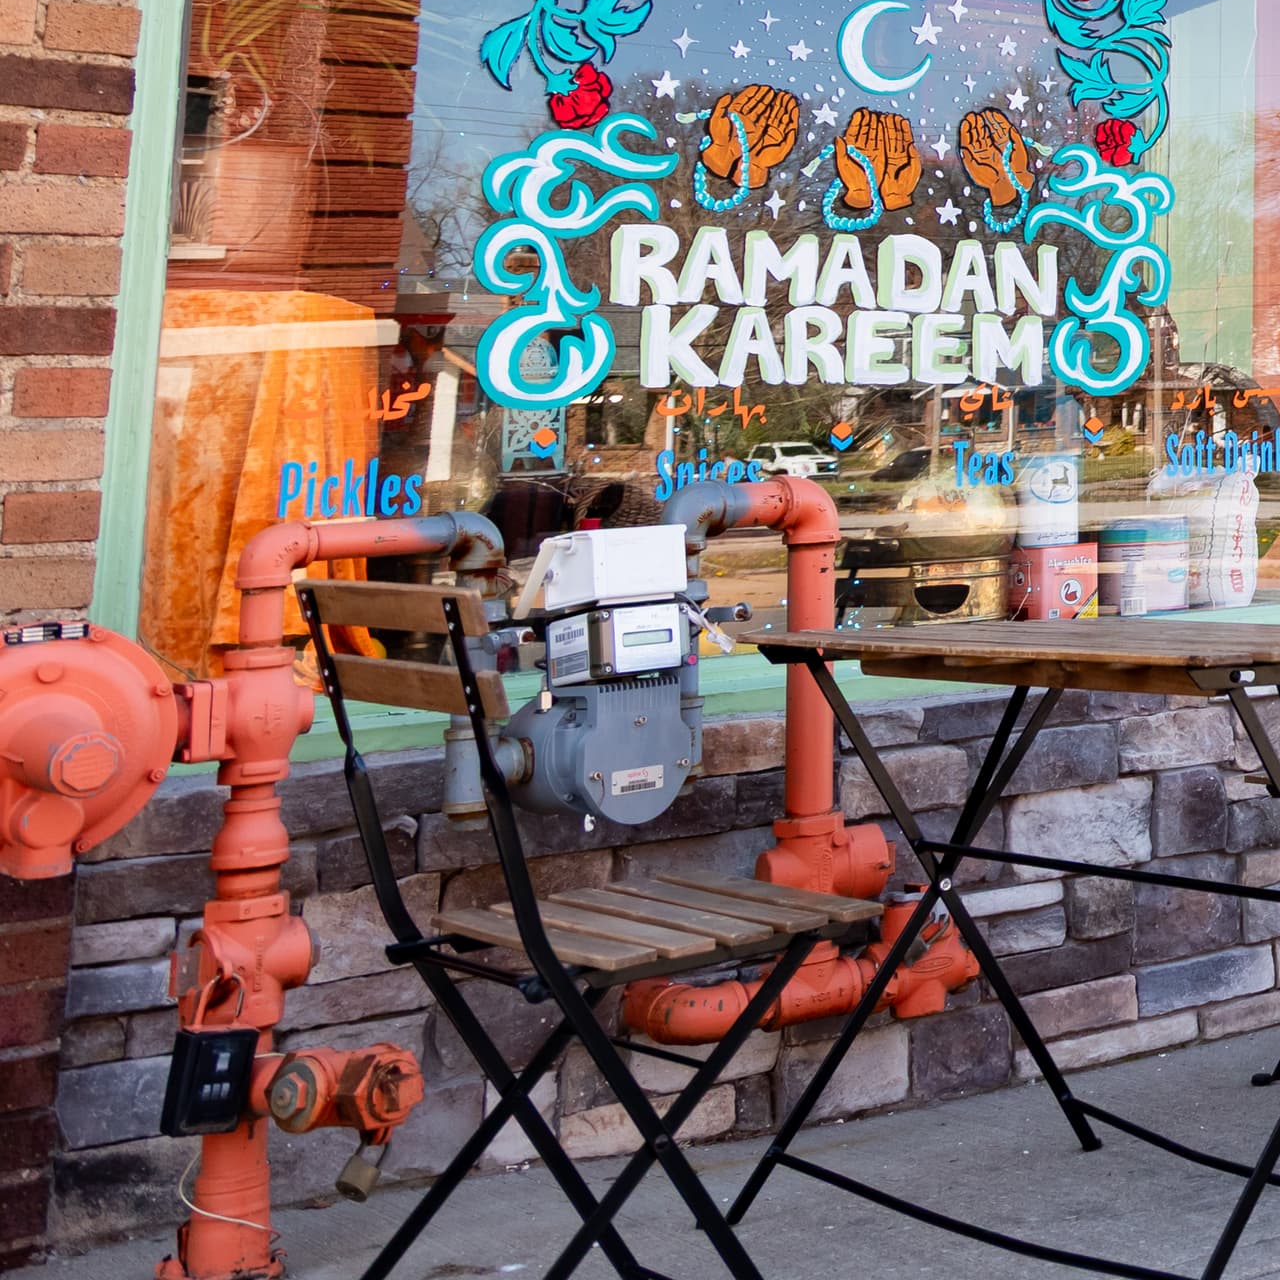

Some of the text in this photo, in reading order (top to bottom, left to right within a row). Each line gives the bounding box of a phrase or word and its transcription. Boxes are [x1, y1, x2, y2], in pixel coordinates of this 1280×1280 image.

[609, 222, 1059, 318] RAMADAN
[639, 303, 1046, 389] KAREEM
[656, 387, 768, 430] بهارات
[953, 439, 1015, 488] Teas
[1166, 430, 1216, 477] Soft
[278, 456, 424, 518] Pickles
